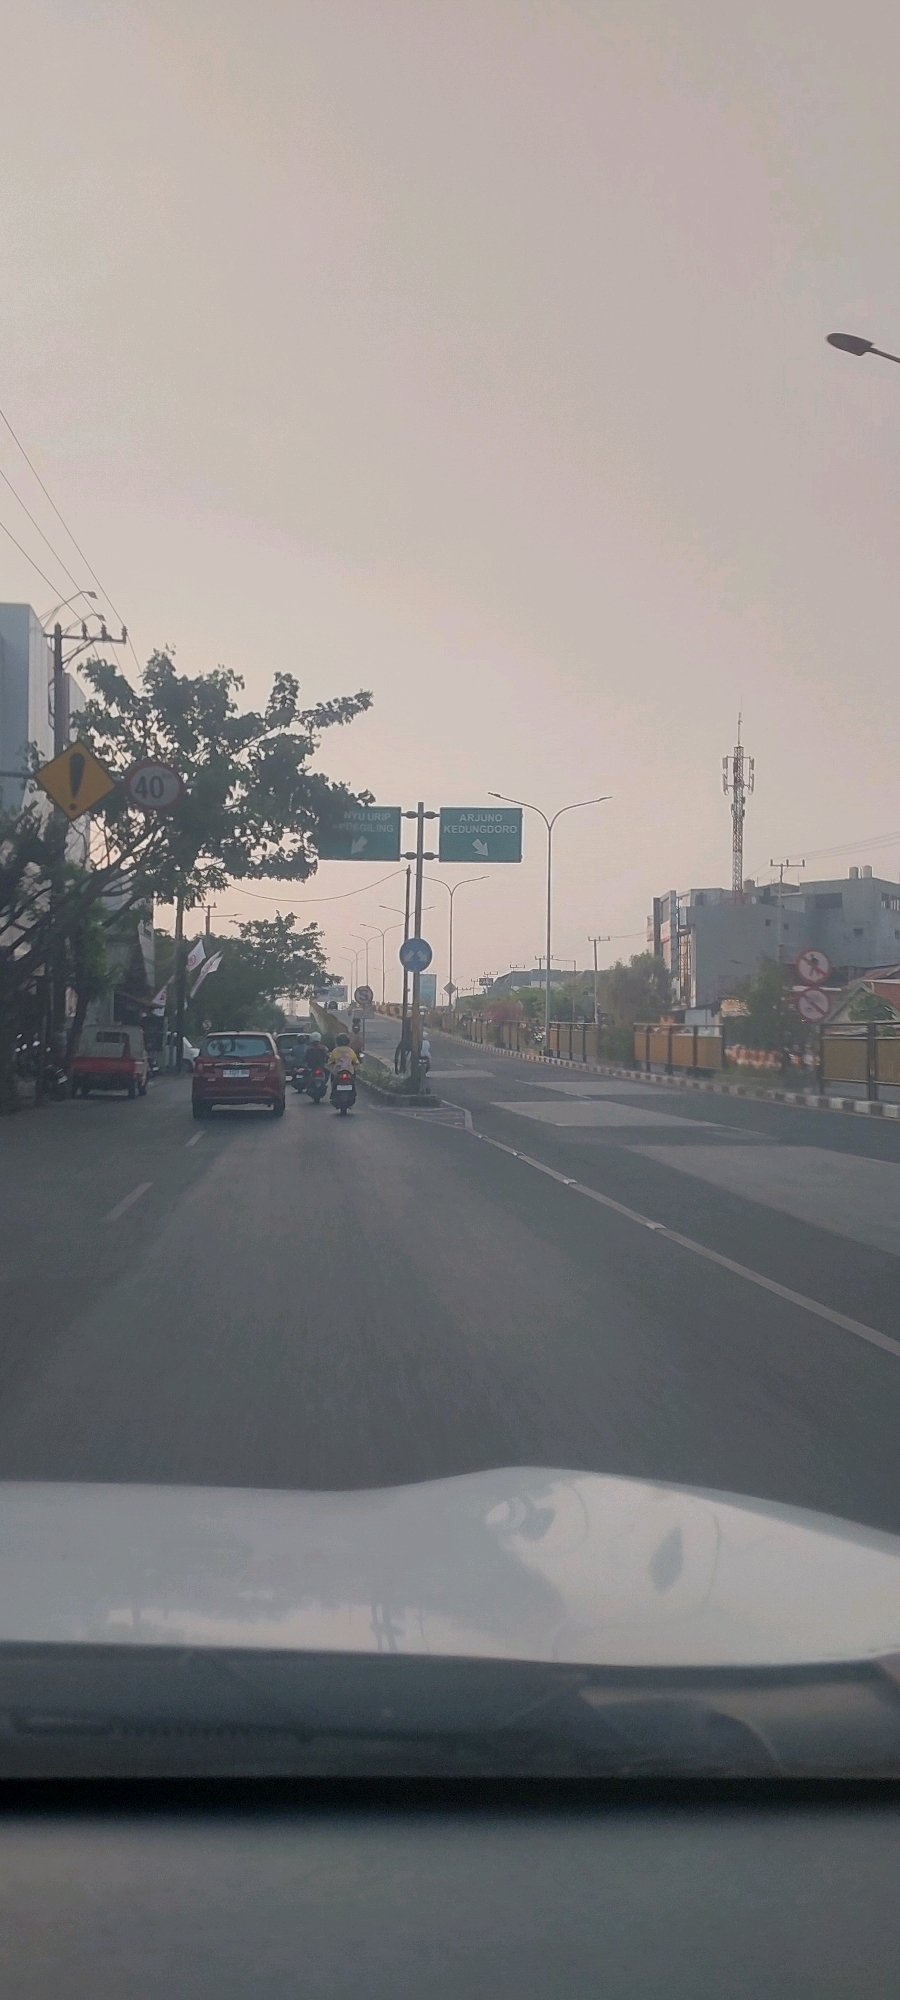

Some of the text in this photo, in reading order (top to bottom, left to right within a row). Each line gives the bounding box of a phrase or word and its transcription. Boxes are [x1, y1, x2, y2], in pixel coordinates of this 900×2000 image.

[135, 775, 165, 799] 40
[367, 812, 391, 821] URIP
[459, 813, 503, 822] ARJUNO
[443, 825, 518, 834] KEDUNGDORO
